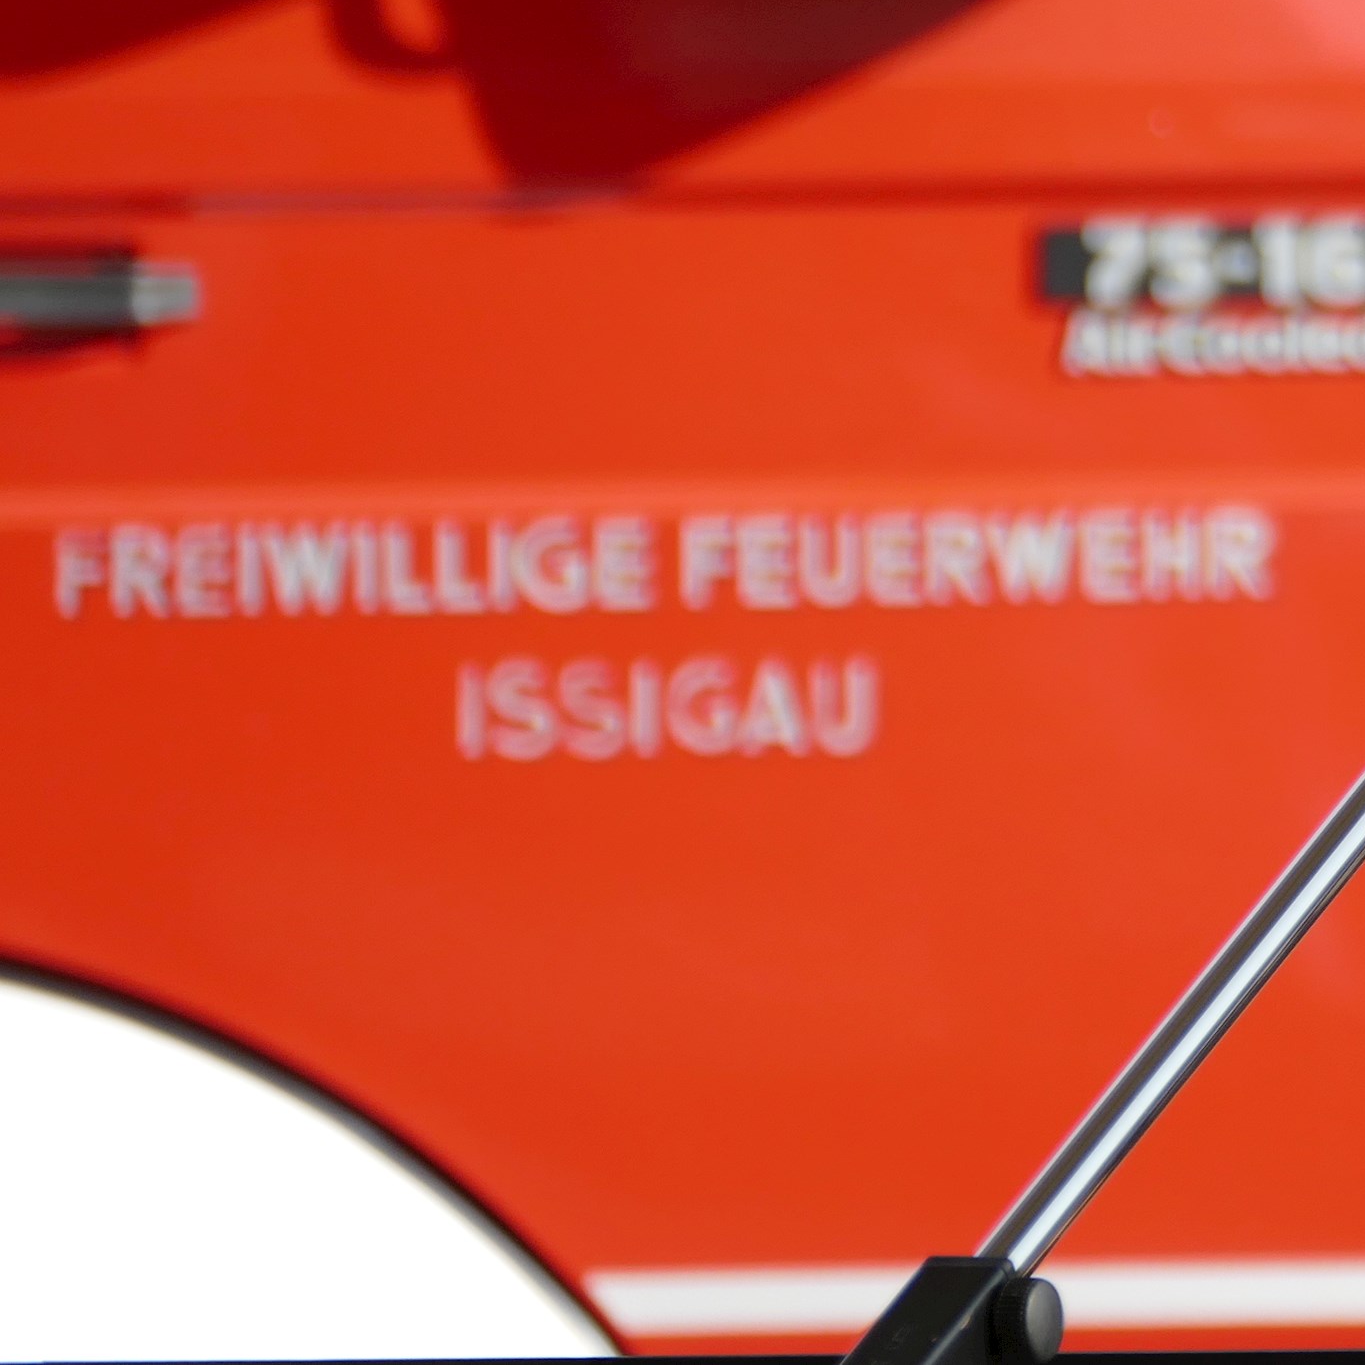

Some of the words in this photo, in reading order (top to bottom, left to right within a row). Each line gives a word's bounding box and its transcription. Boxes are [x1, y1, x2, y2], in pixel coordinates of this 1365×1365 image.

[54, 521, 656, 615] FREIWILLIGE
[679, 509, 1276, 609] FEUERWEHR
[456, 659, 878, 756] ISSIGAU
